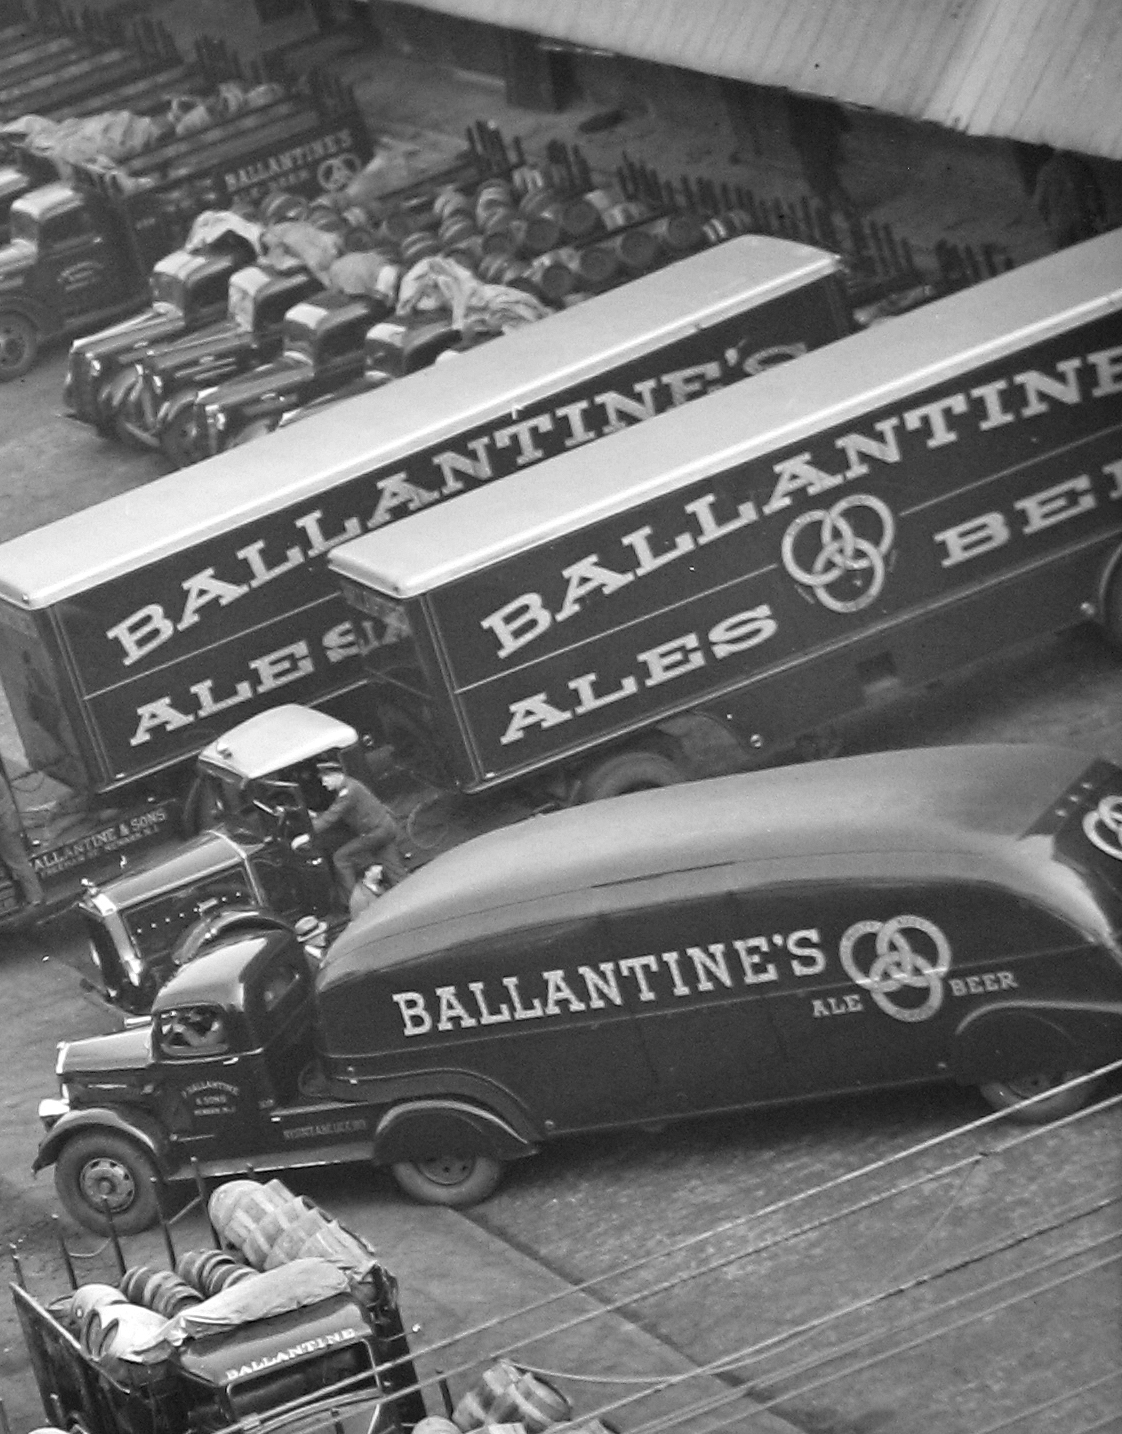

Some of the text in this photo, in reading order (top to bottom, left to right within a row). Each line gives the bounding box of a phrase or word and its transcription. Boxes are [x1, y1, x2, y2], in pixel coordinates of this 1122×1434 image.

[480, 346, 1122, 659] BALLANTINE
[933, 458, 1122, 568] BE
[500, 604, 779, 746] ALES
[29, 827, 117, 872] ALLANTINE
[392, 929, 826, 1037] BALLANTINE'S
[810, 993, 864, 1019] ALE
[948, 970, 1019, 997] BEER
